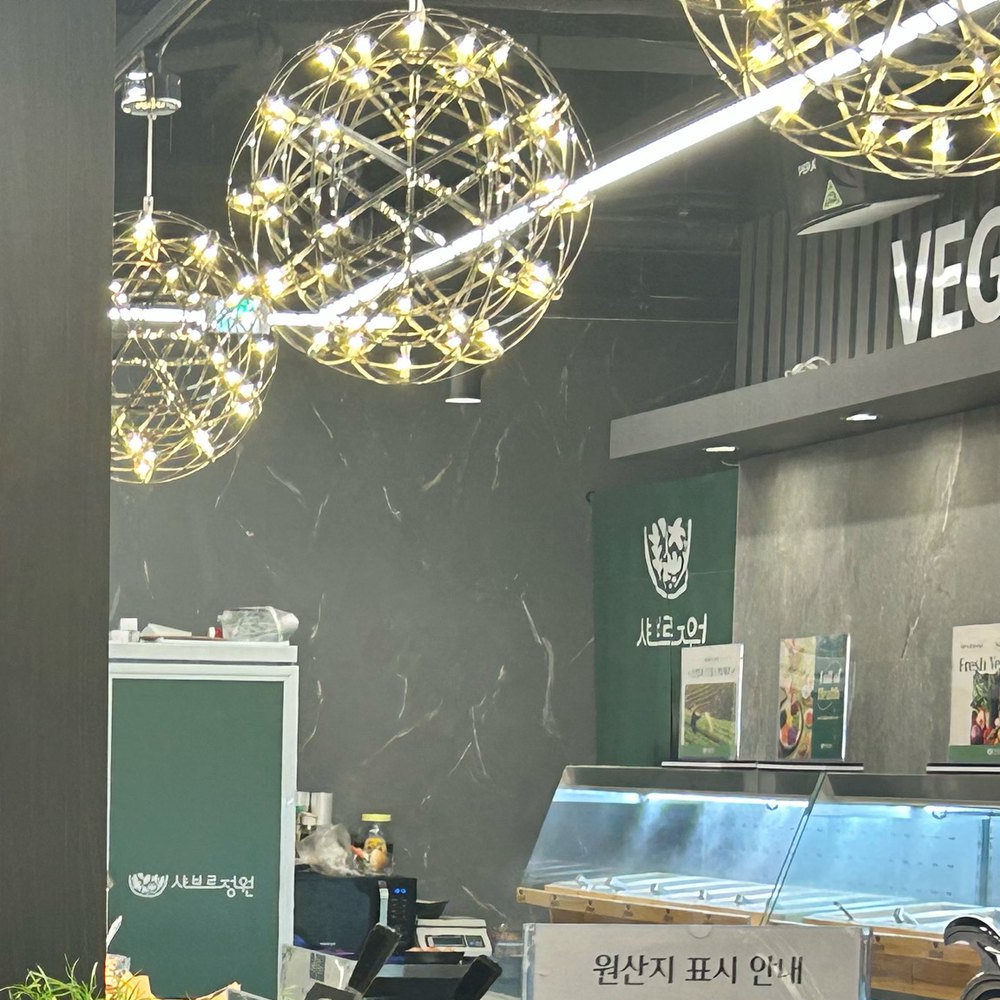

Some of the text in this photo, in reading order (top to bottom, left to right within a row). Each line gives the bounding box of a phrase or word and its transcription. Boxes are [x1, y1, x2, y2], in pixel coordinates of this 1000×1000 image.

[593, 954, 803, 986] 원산지 표시 안내
